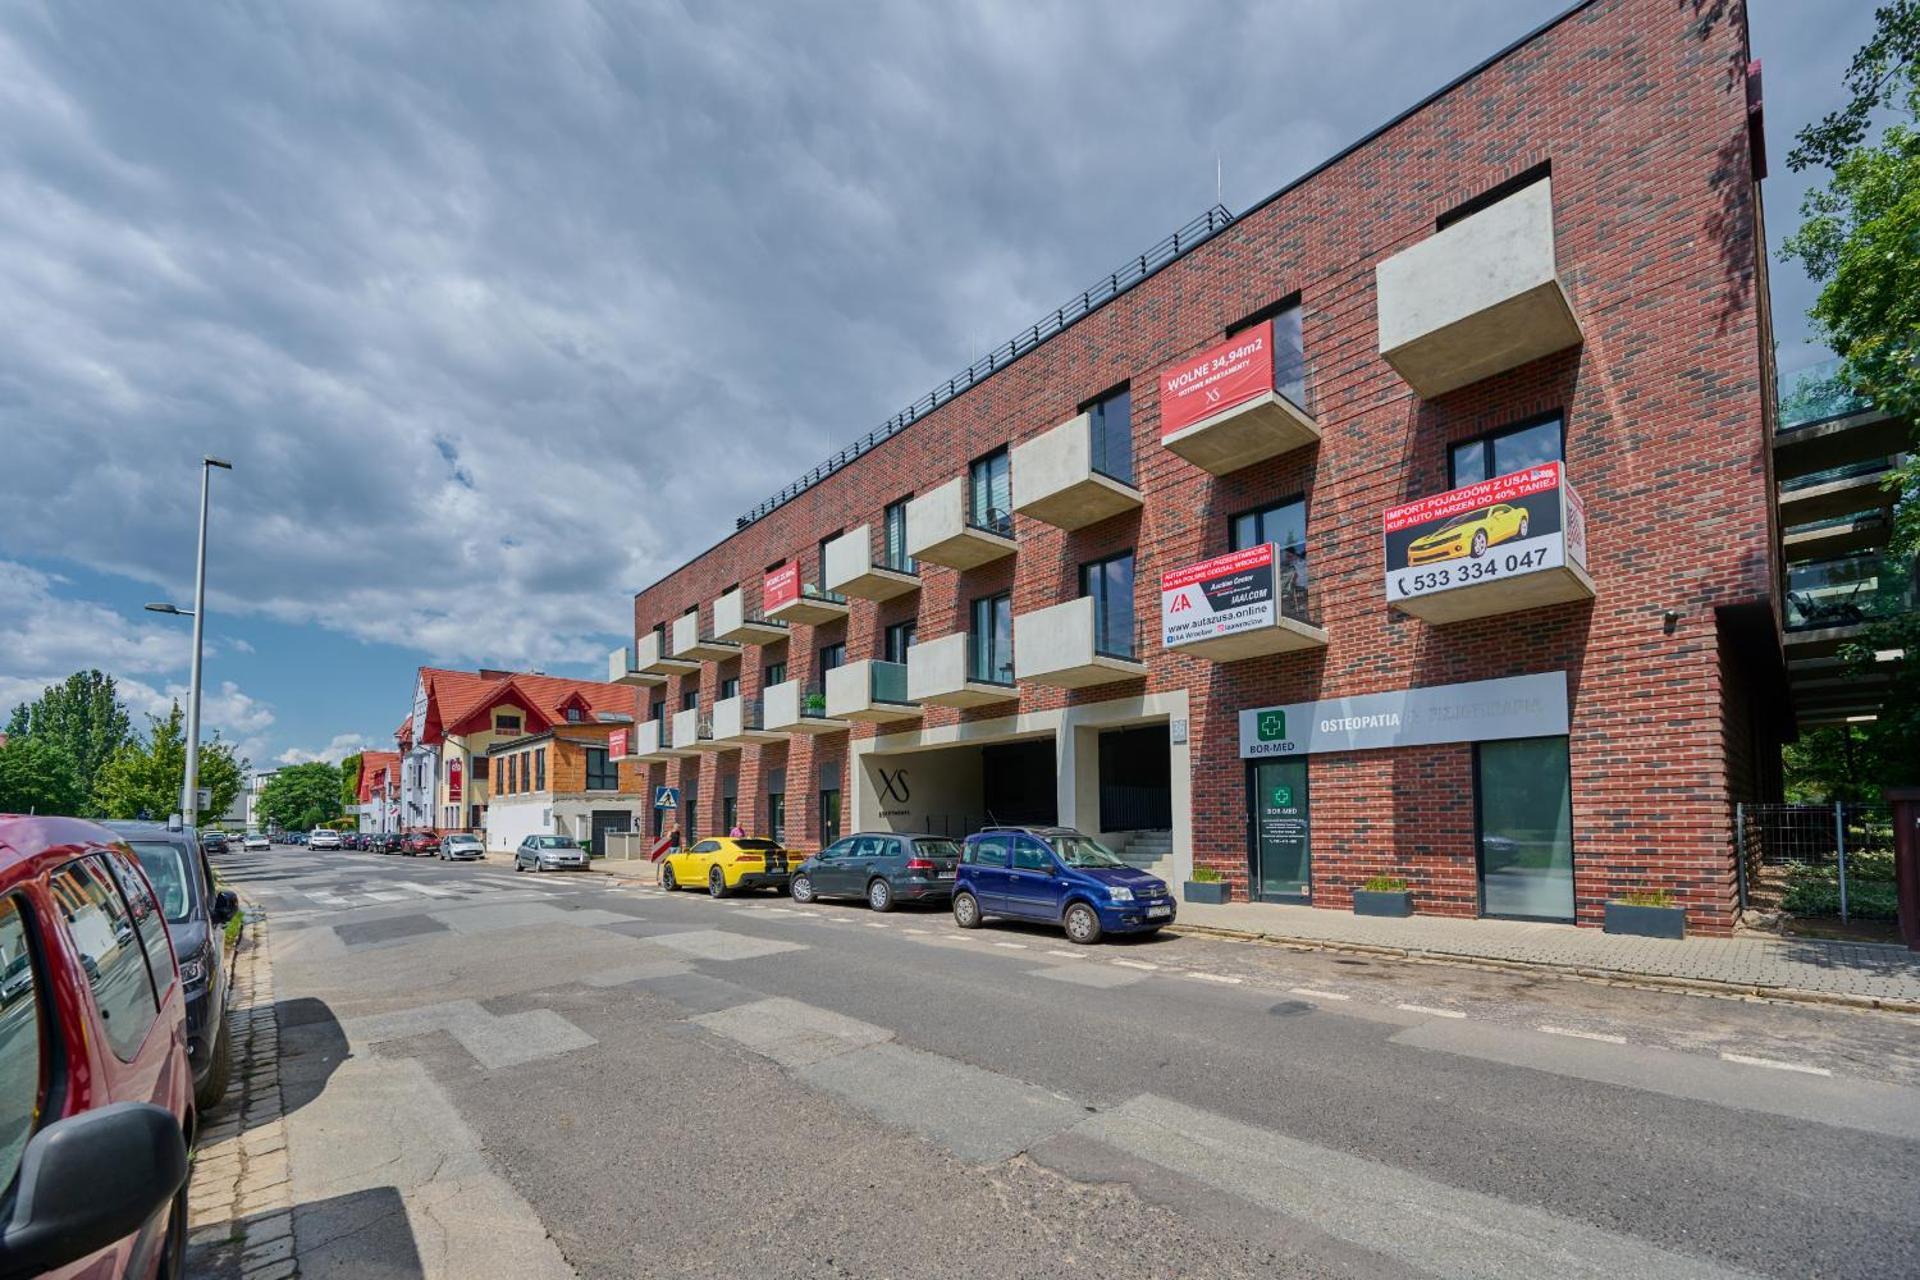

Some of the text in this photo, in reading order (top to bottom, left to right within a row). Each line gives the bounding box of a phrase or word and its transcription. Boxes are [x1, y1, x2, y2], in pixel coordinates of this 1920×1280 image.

[1168, 338, 1263, 392] WOLNE 34,94m2
[1387, 474, 1529, 520] IMPORT POJAZDÓW Z USA
[1387, 519, 1405, 530] KUP
[1407, 511, 1433, 523] AUTO
[1477, 494, 1493, 505] DO
[1495, 488, 1516, 500] 40%
[1519, 477, 1557, 494] TANIEJ
[1414, 548, 1548, 592] 533 334 047
[1168, 605, 1268, 633] www.autazusa.online
[1320, 712, 1400, 733] OSTEOPATIA
[1250, 741, 1295, 754] BOR-MED
[878, 768, 910, 803] XS
